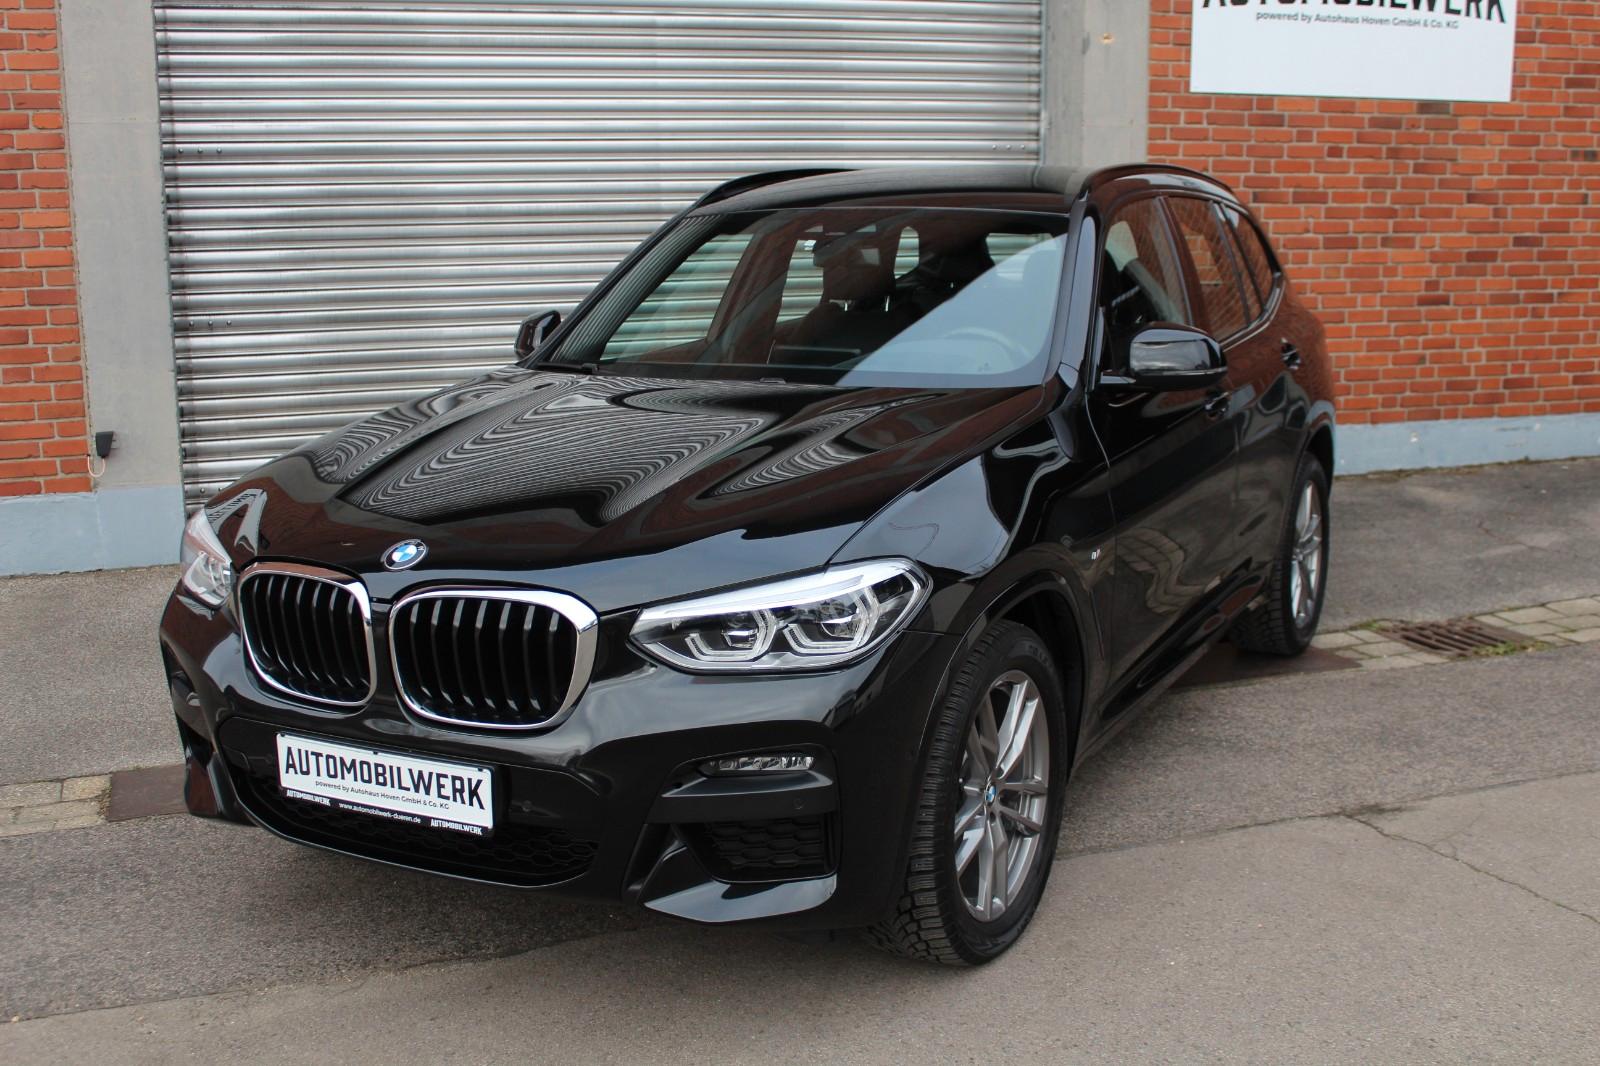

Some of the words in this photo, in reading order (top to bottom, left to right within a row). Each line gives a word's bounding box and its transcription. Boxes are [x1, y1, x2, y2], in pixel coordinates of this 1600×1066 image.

[1256, 12, 1298, 21] powered
[1301, 13, 1312, 23] by
[1315, 14, 1359, 24] Autohaus
[1361, 16, 1390, 25] Hoven
[1392, 17, 1421, 27] GmbH
[1423, 19, 1429, 28] &
[1431, 20, 1442, 28] Co.
[1446, 21, 1459, 29] KG
[285, 746, 486, 810] AUTOMOBILWERK
[286, 789, 331, 806] AUTOMOBILWERK
[315, 780, 341, 790] powered
[342, 784, 350, 793] by
[350, 787, 379, 798] Autohaus
[381, 792, 400, 801] Hoven
[401, 796, 421, 805] GmbH
[430, 819, 483, 835] AUTOMOBILWERK
